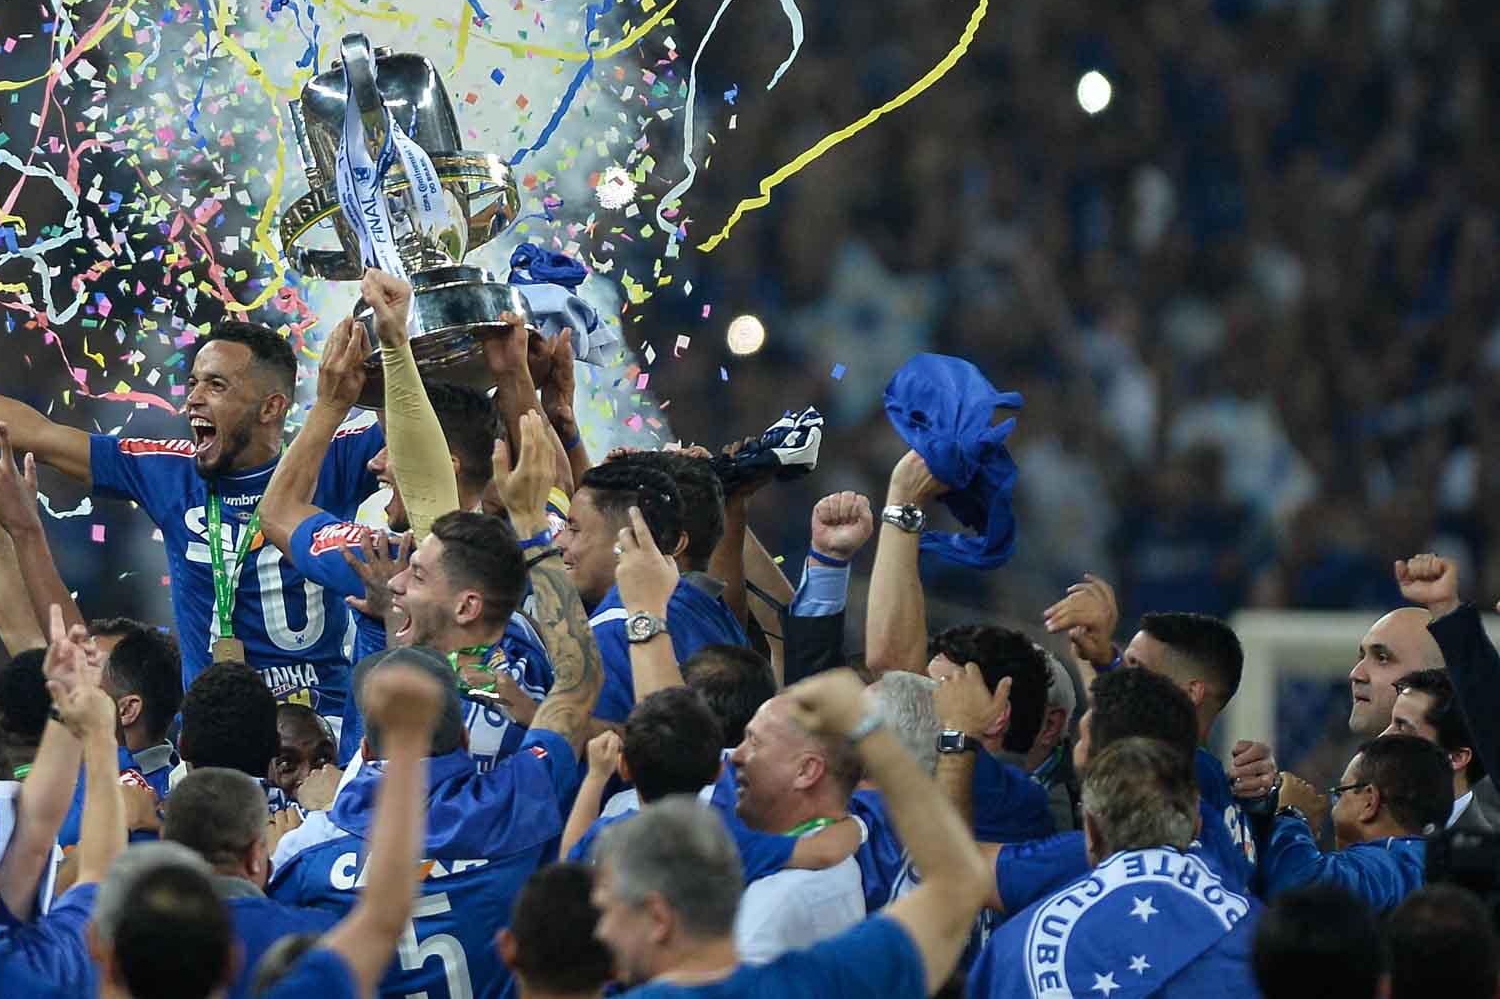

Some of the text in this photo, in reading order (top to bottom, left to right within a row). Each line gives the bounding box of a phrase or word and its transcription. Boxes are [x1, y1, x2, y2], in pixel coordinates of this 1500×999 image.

[361, 198, 387, 243] FINAL
[257, 662, 320, 689] INHA
[398, 891, 475, 999] 5
[1037, 876, 1105, 993] CLUBE
